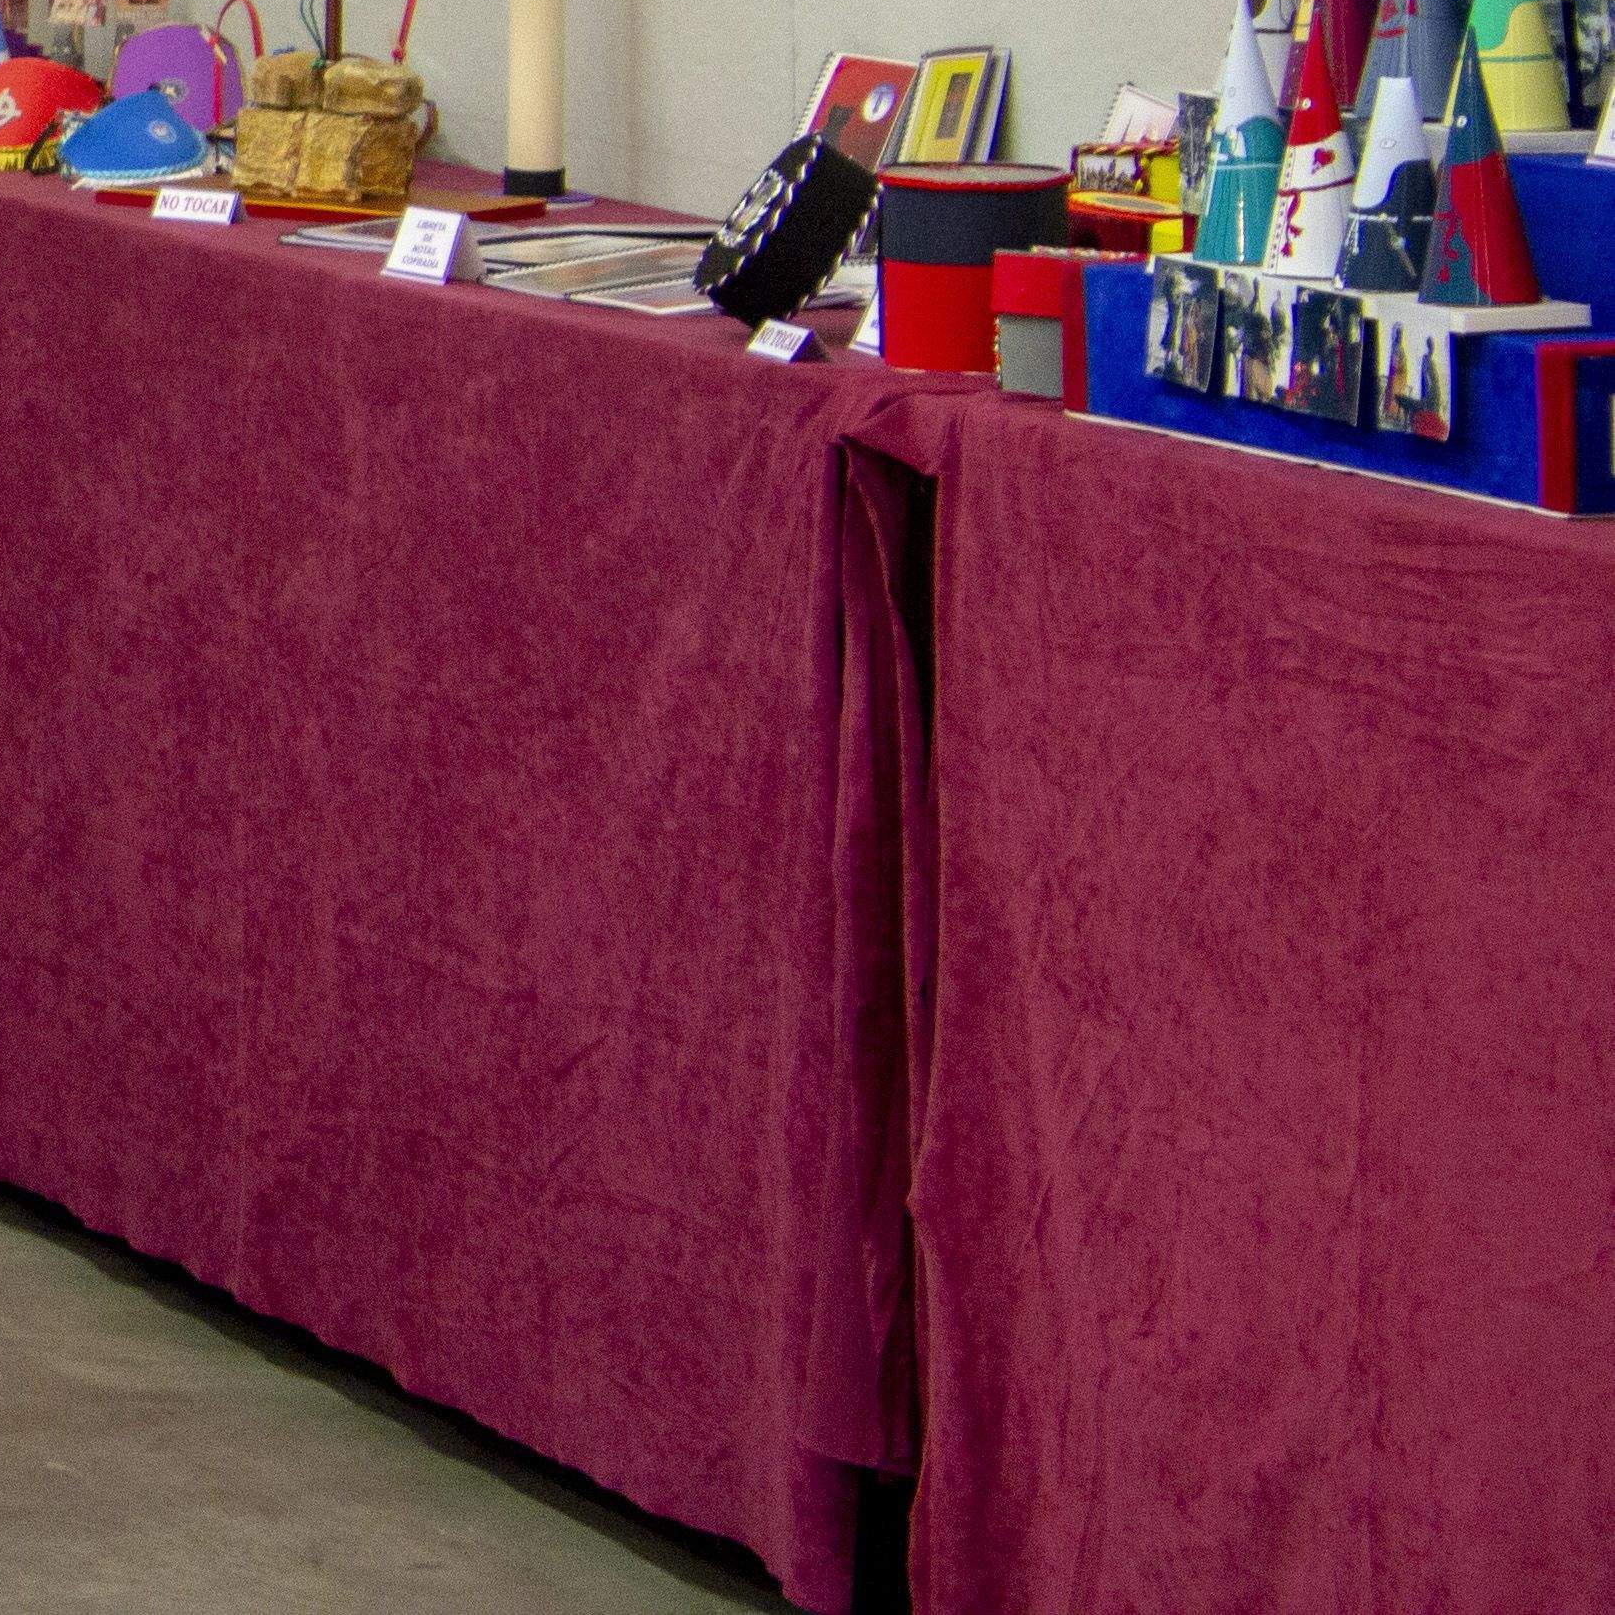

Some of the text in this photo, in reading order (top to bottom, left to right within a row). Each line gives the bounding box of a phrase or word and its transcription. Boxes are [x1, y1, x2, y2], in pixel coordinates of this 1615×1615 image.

[159, 193, 229, 215] NO TOCAR
[417, 220, 446, 232] LIBRETA
[423, 233, 433, 242] DE
[412, 245, 437, 256] NOTAS
